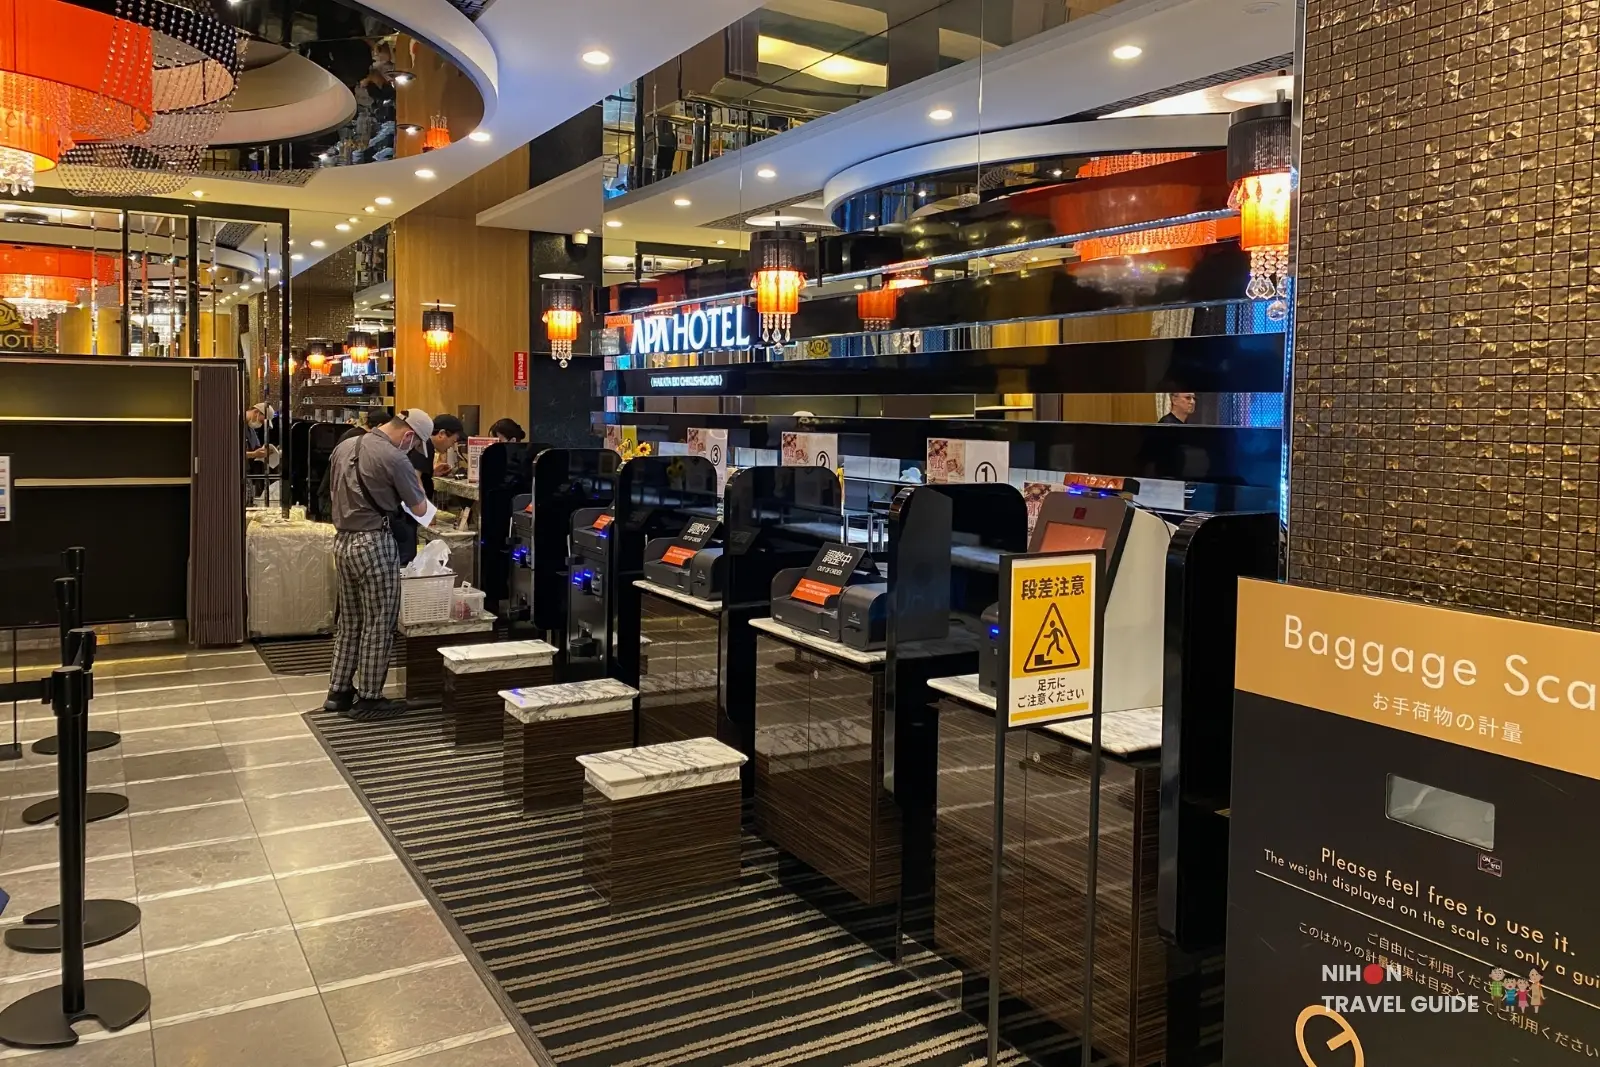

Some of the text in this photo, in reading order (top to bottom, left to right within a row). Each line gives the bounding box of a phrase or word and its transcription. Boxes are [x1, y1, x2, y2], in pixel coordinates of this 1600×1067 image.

[630, 304, 750, 354] APA HOTEL
[816, 565, 824, 573] OUT
[829, 568, 843, 576] ORDER
[1021, 575, 1085, 600] 段差注意
[1284, 614, 1477, 689] Baggage
[1017, 688, 1085, 708] ご注意ください
[1037, 677, 1066, 692] 足元に
[1372, 692, 1524, 745] お手荷物の計量
[1264, 848, 1285, 867] The
[1288, 861, 1328, 883] weight
[1332, 876, 1395, 909] displayed
[1400, 905, 1417, 918] on
[1423, 911, 1445, 929] the
[1451, 924, 1490, 946] scale
[1496, 938, 1508, 954] is
[1514, 949, 1549, 971] only
[1555, 965, 1566, 976] a
[1321, 847, 1575, 956] Please feel free to use it.
[1367, 932, 1498, 993] ご自由にご利用くださ
